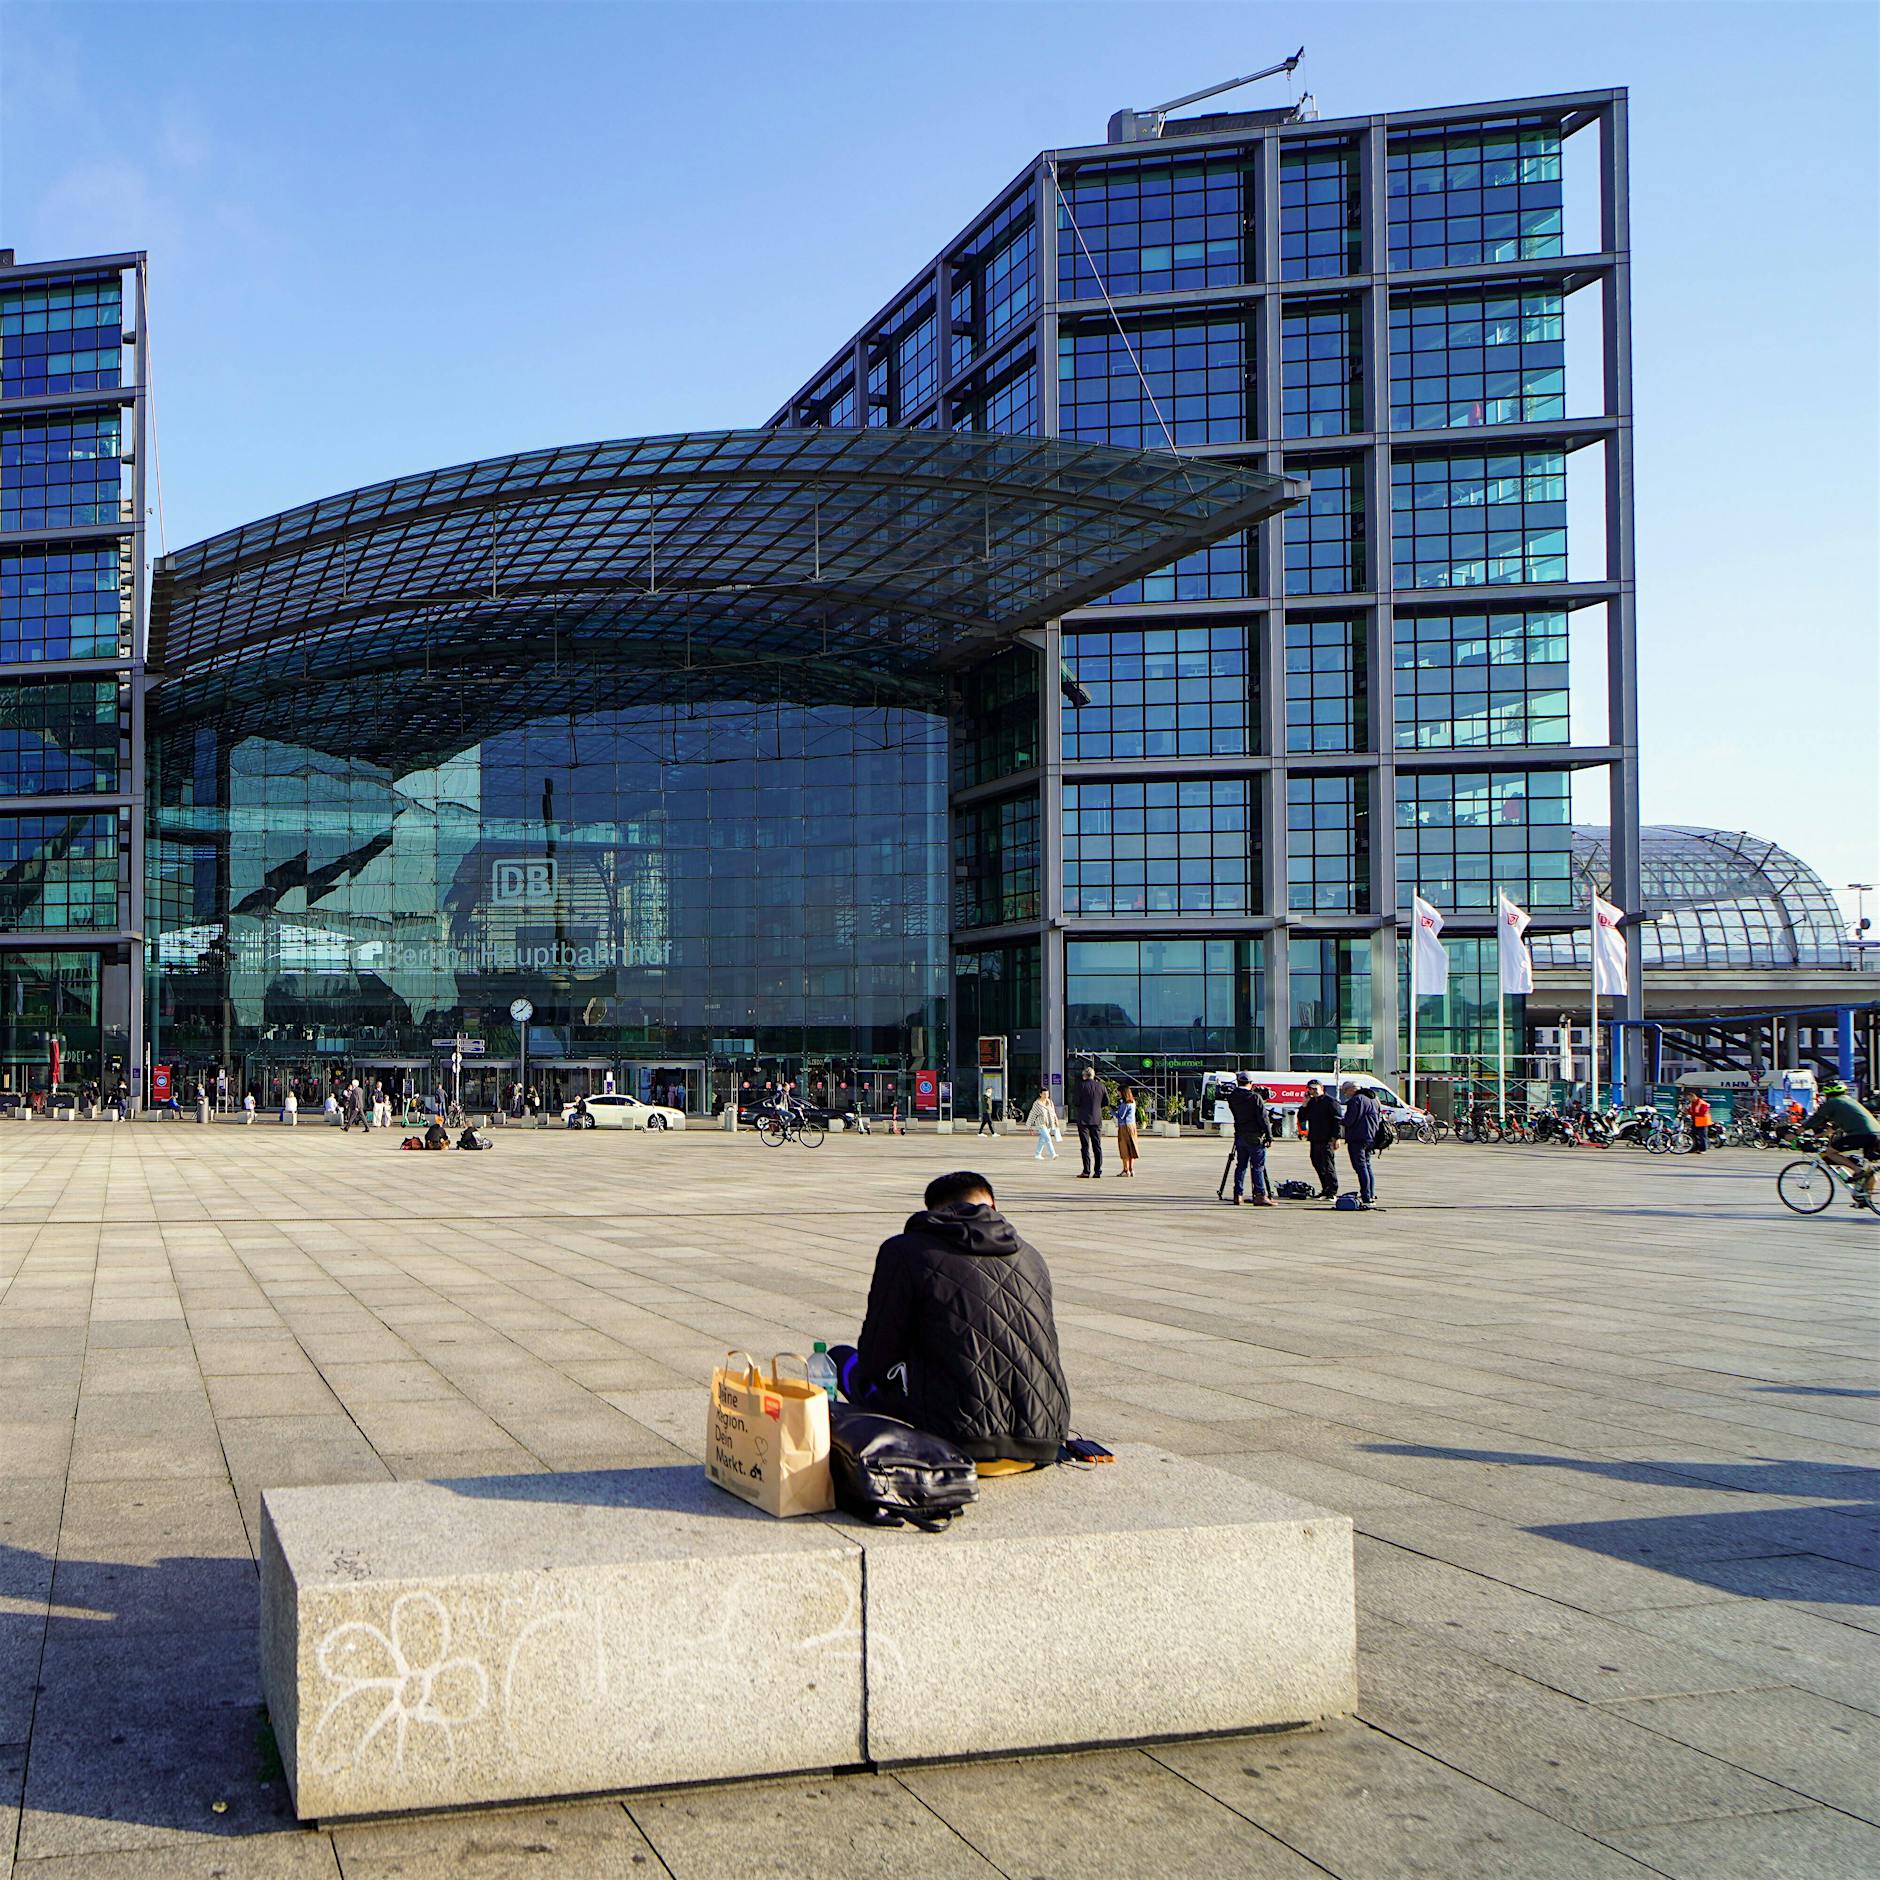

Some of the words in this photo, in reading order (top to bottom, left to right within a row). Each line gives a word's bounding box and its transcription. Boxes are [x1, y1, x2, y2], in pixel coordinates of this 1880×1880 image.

[501, 866, 550, 897] DB
[385, 941, 461, 967] Berlin
[480, 941, 673, 970] Hauptbahnhof
[67, 1050, 86, 1063] PRET
[716, 1446, 747, 1476] Markt.
